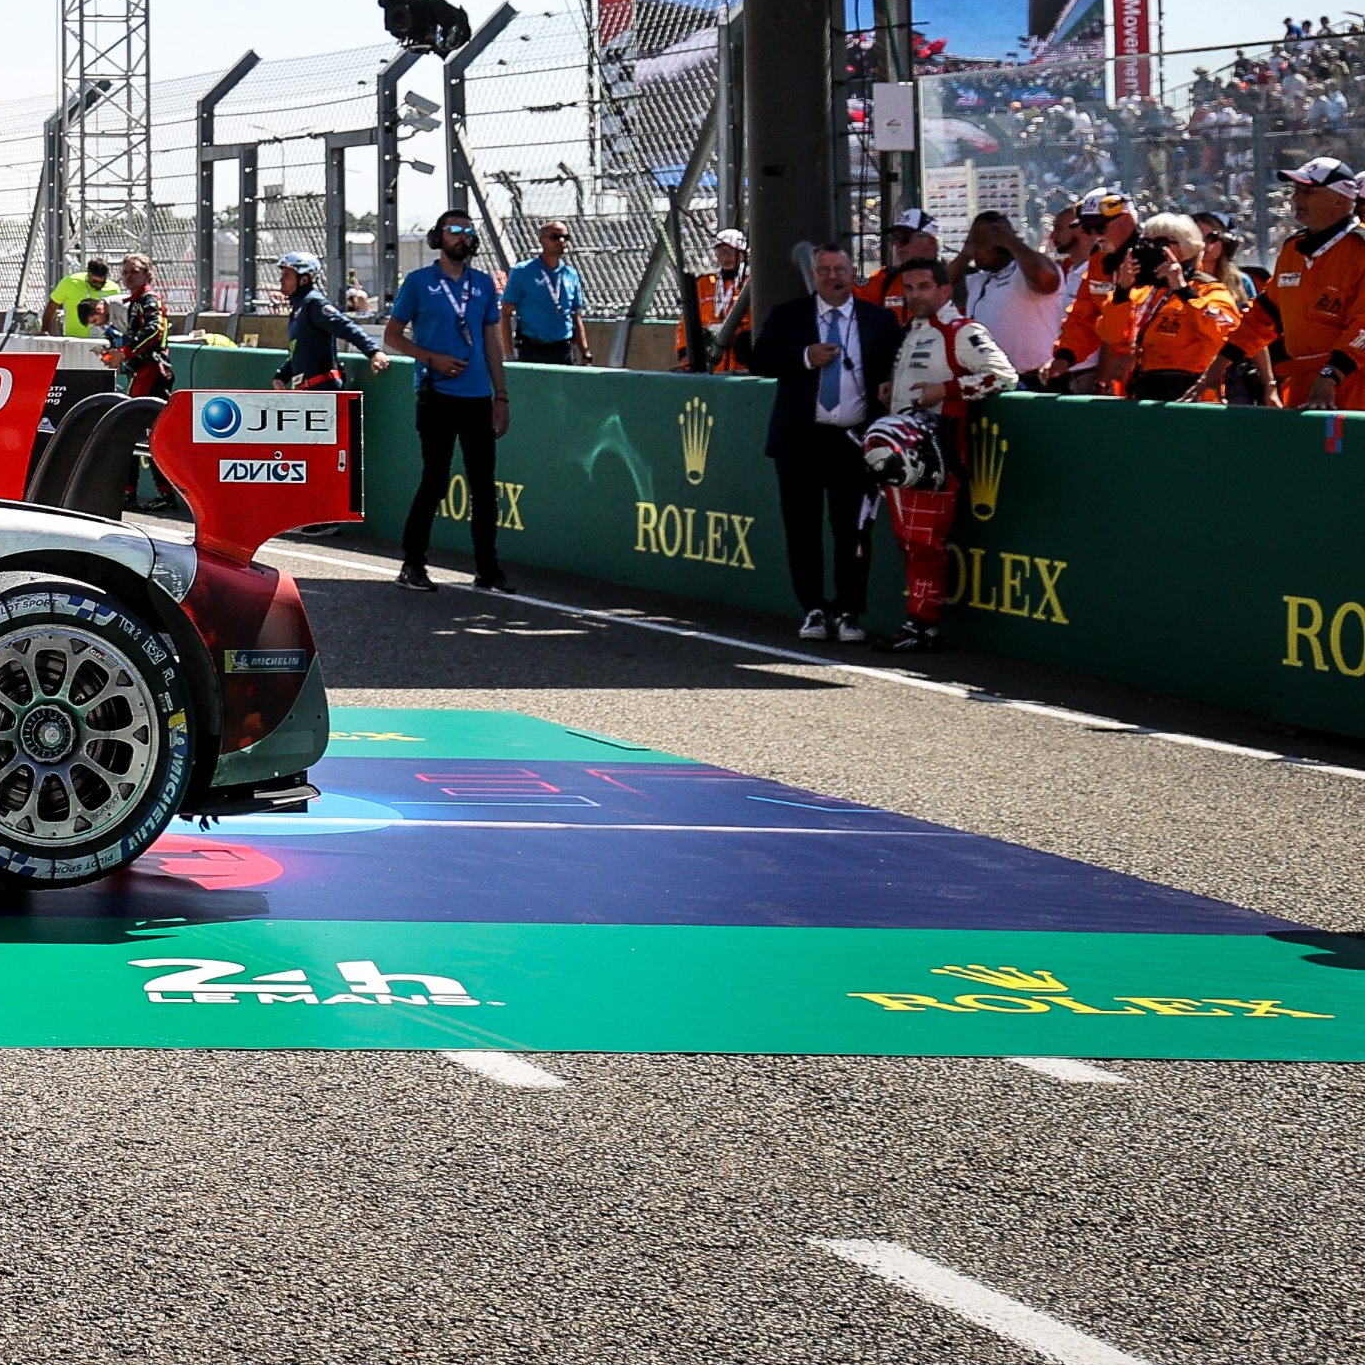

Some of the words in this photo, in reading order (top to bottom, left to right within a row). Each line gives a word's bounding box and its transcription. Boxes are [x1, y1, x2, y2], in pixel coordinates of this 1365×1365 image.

[247, 409, 329, 431] JFE
[222, 461, 305, 482] ADVICS
[635, 502, 756, 570] ROLEX
[945, 540, 1070, 625] OLEX
[21, 598, 58, 609] SPORT
[251, 656, 299, 665] MICHELIN
[129, 753, 184, 850] MICHELIN
[127, 958, 468, 994] 24h
[147, 992, 240, 1005] LE
[257, 992, 481, 1006] MANS
[846, 990, 1337, 1020] ROLEX
